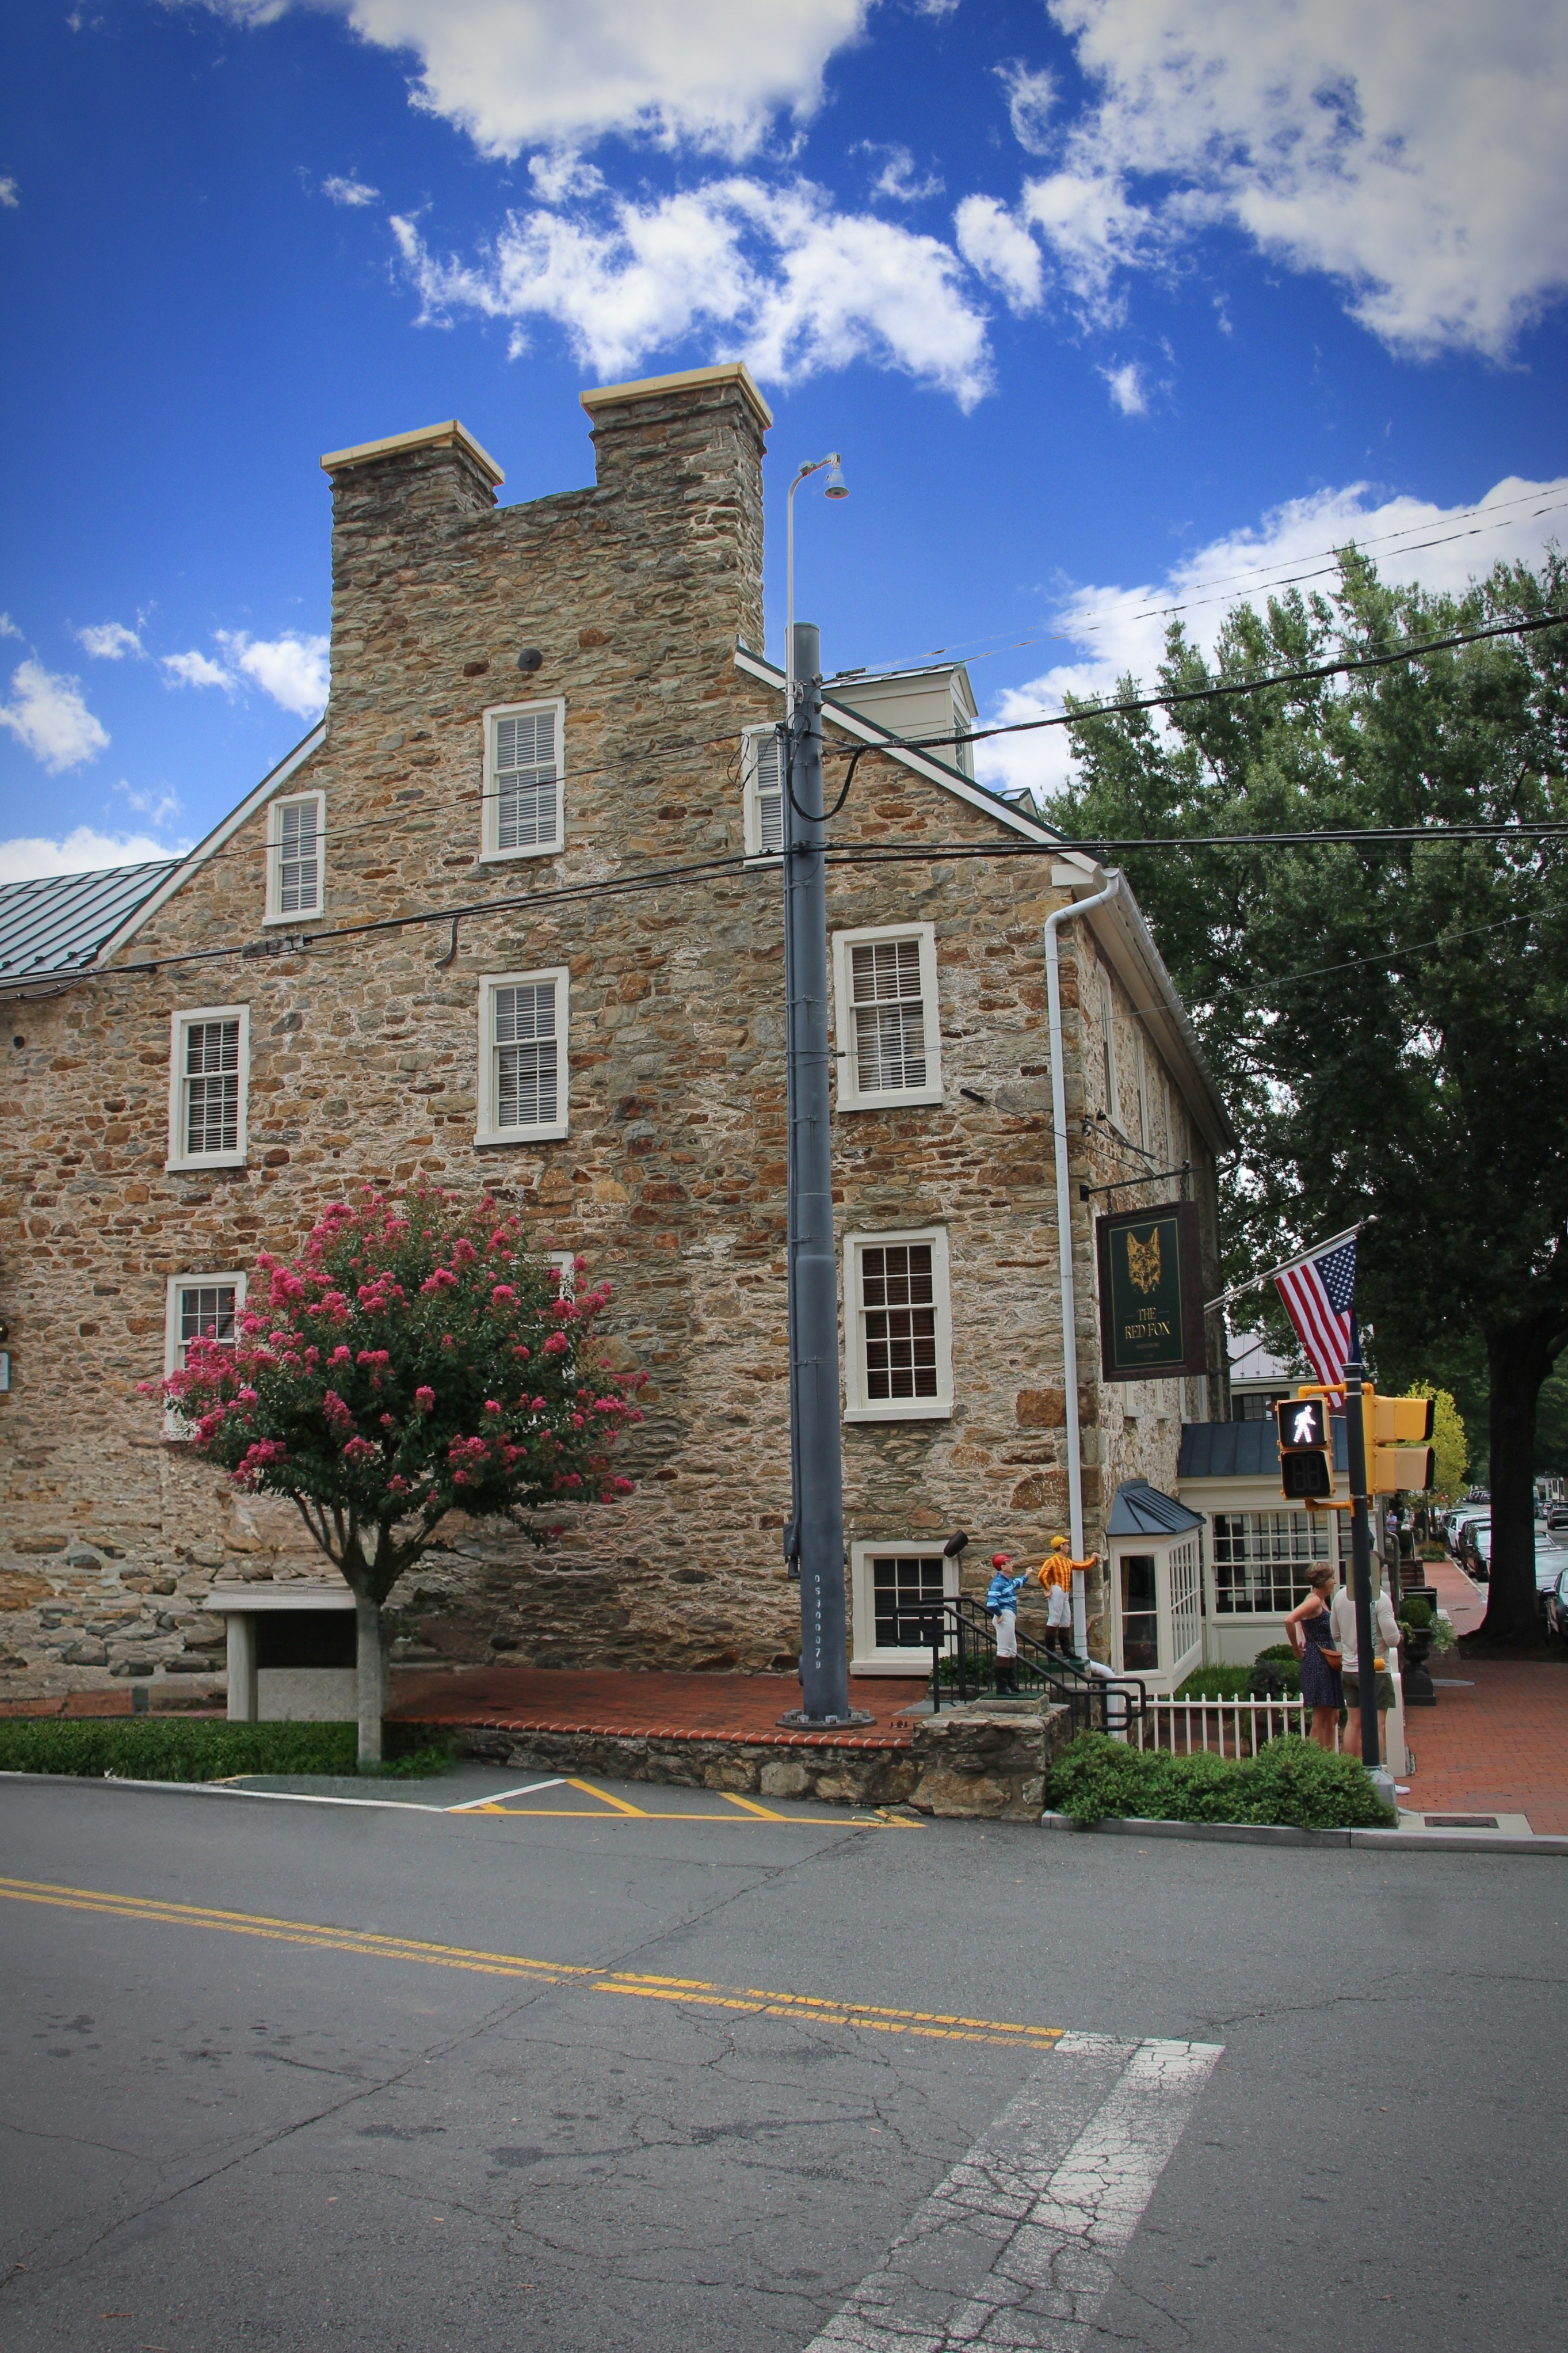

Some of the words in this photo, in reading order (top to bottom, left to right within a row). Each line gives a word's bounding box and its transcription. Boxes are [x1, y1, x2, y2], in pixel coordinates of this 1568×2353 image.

[1137, 1307, 1157, 1321] THE
[1125, 1324, 1146, 1339] RED
[1148, 1321, 1170, 1337] FOX
